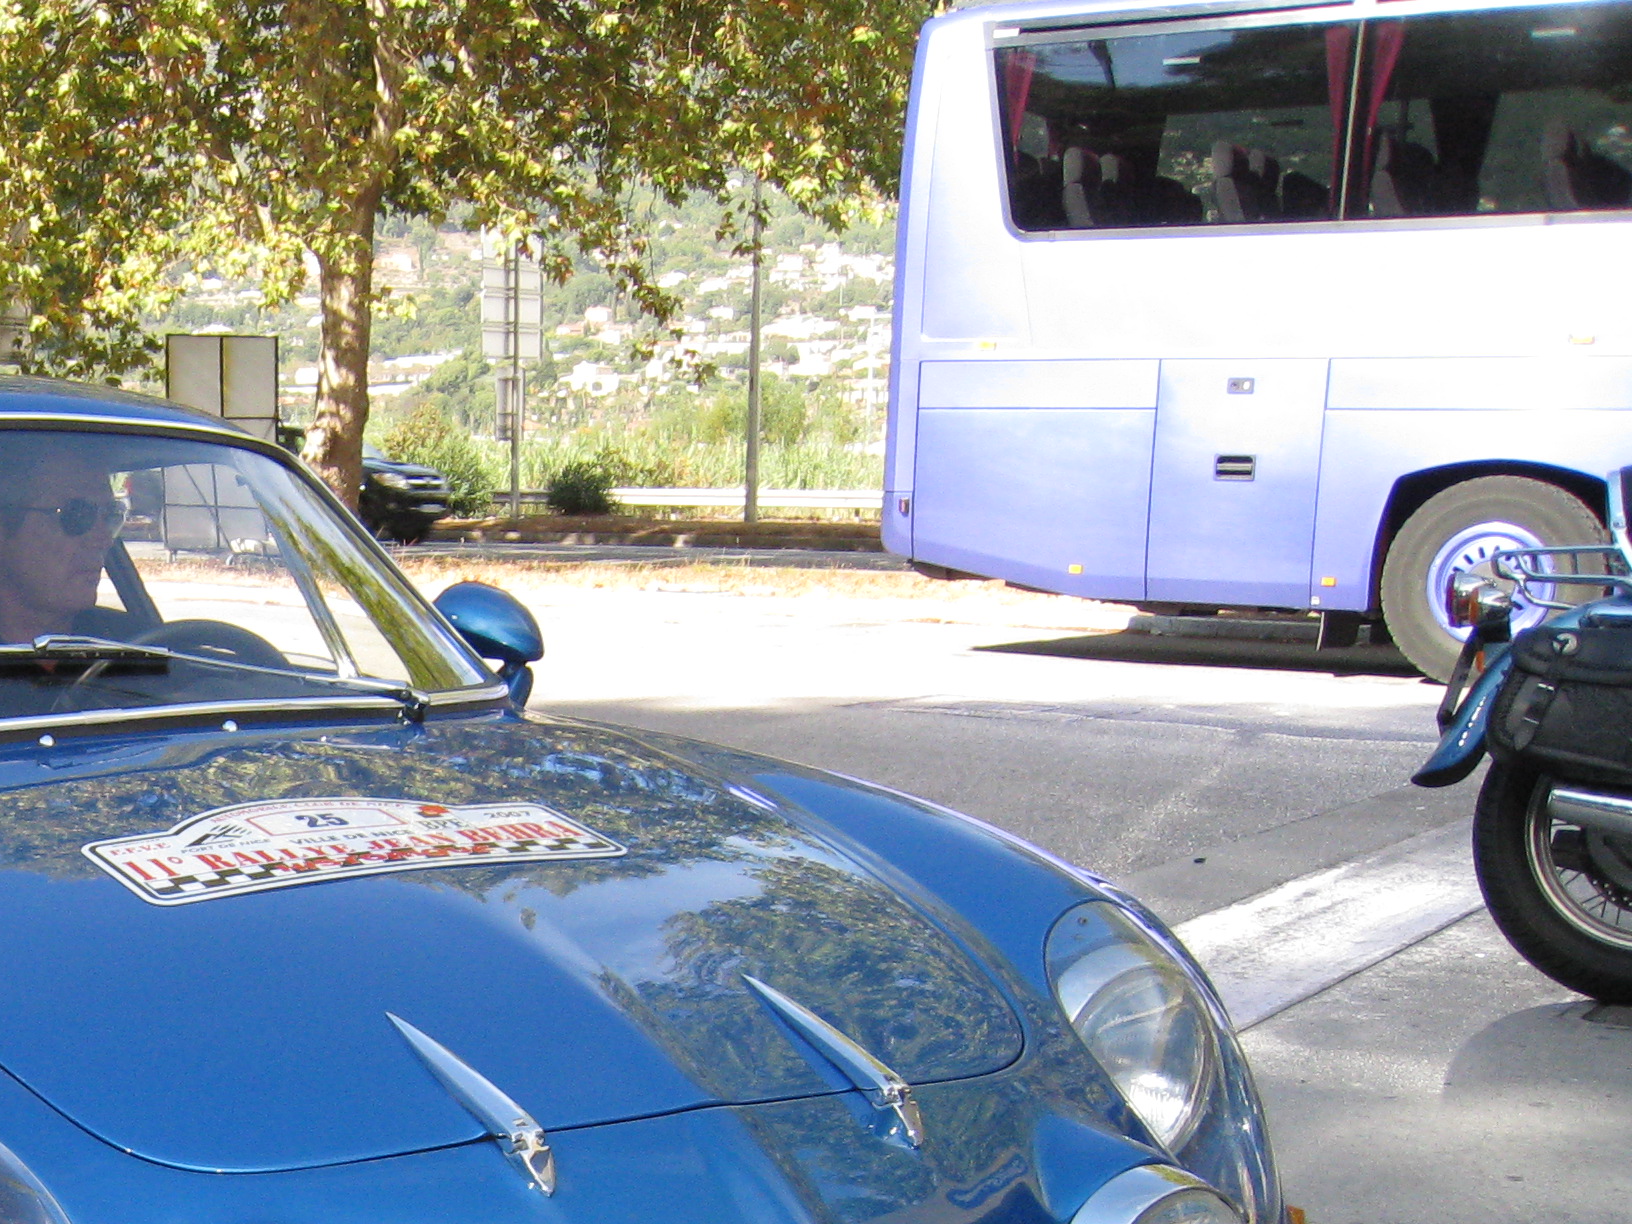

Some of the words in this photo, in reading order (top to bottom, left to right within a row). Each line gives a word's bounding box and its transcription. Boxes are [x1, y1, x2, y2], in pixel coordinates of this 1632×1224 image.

[294, 813, 349, 828] 25
[483, 810, 532, 819] 2007
[192, 843, 355, 871] RALLYE
[368, 832, 457, 851] JEAN
[454, 821, 585, 843] BEHRA
[289, 836, 341, 845] VILLE
